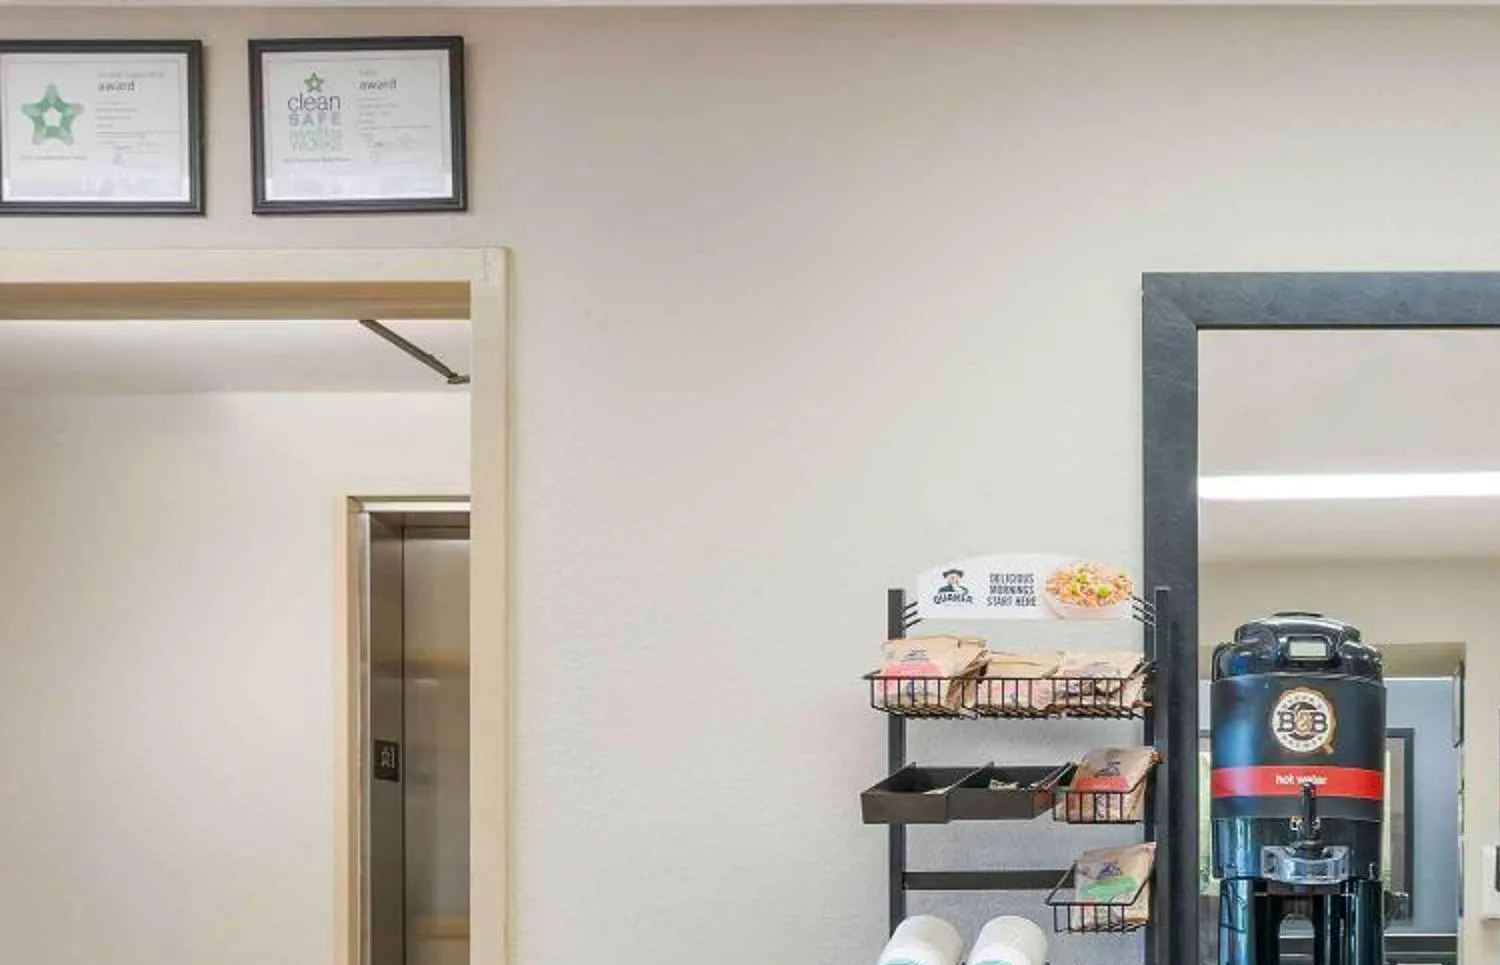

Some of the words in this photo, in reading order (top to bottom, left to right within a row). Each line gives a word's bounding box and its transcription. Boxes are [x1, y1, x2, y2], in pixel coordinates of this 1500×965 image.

[287, 92, 341, 112] clean
[986, 596, 1013, 606] START
[1275, 774, 1295, 785] hot
